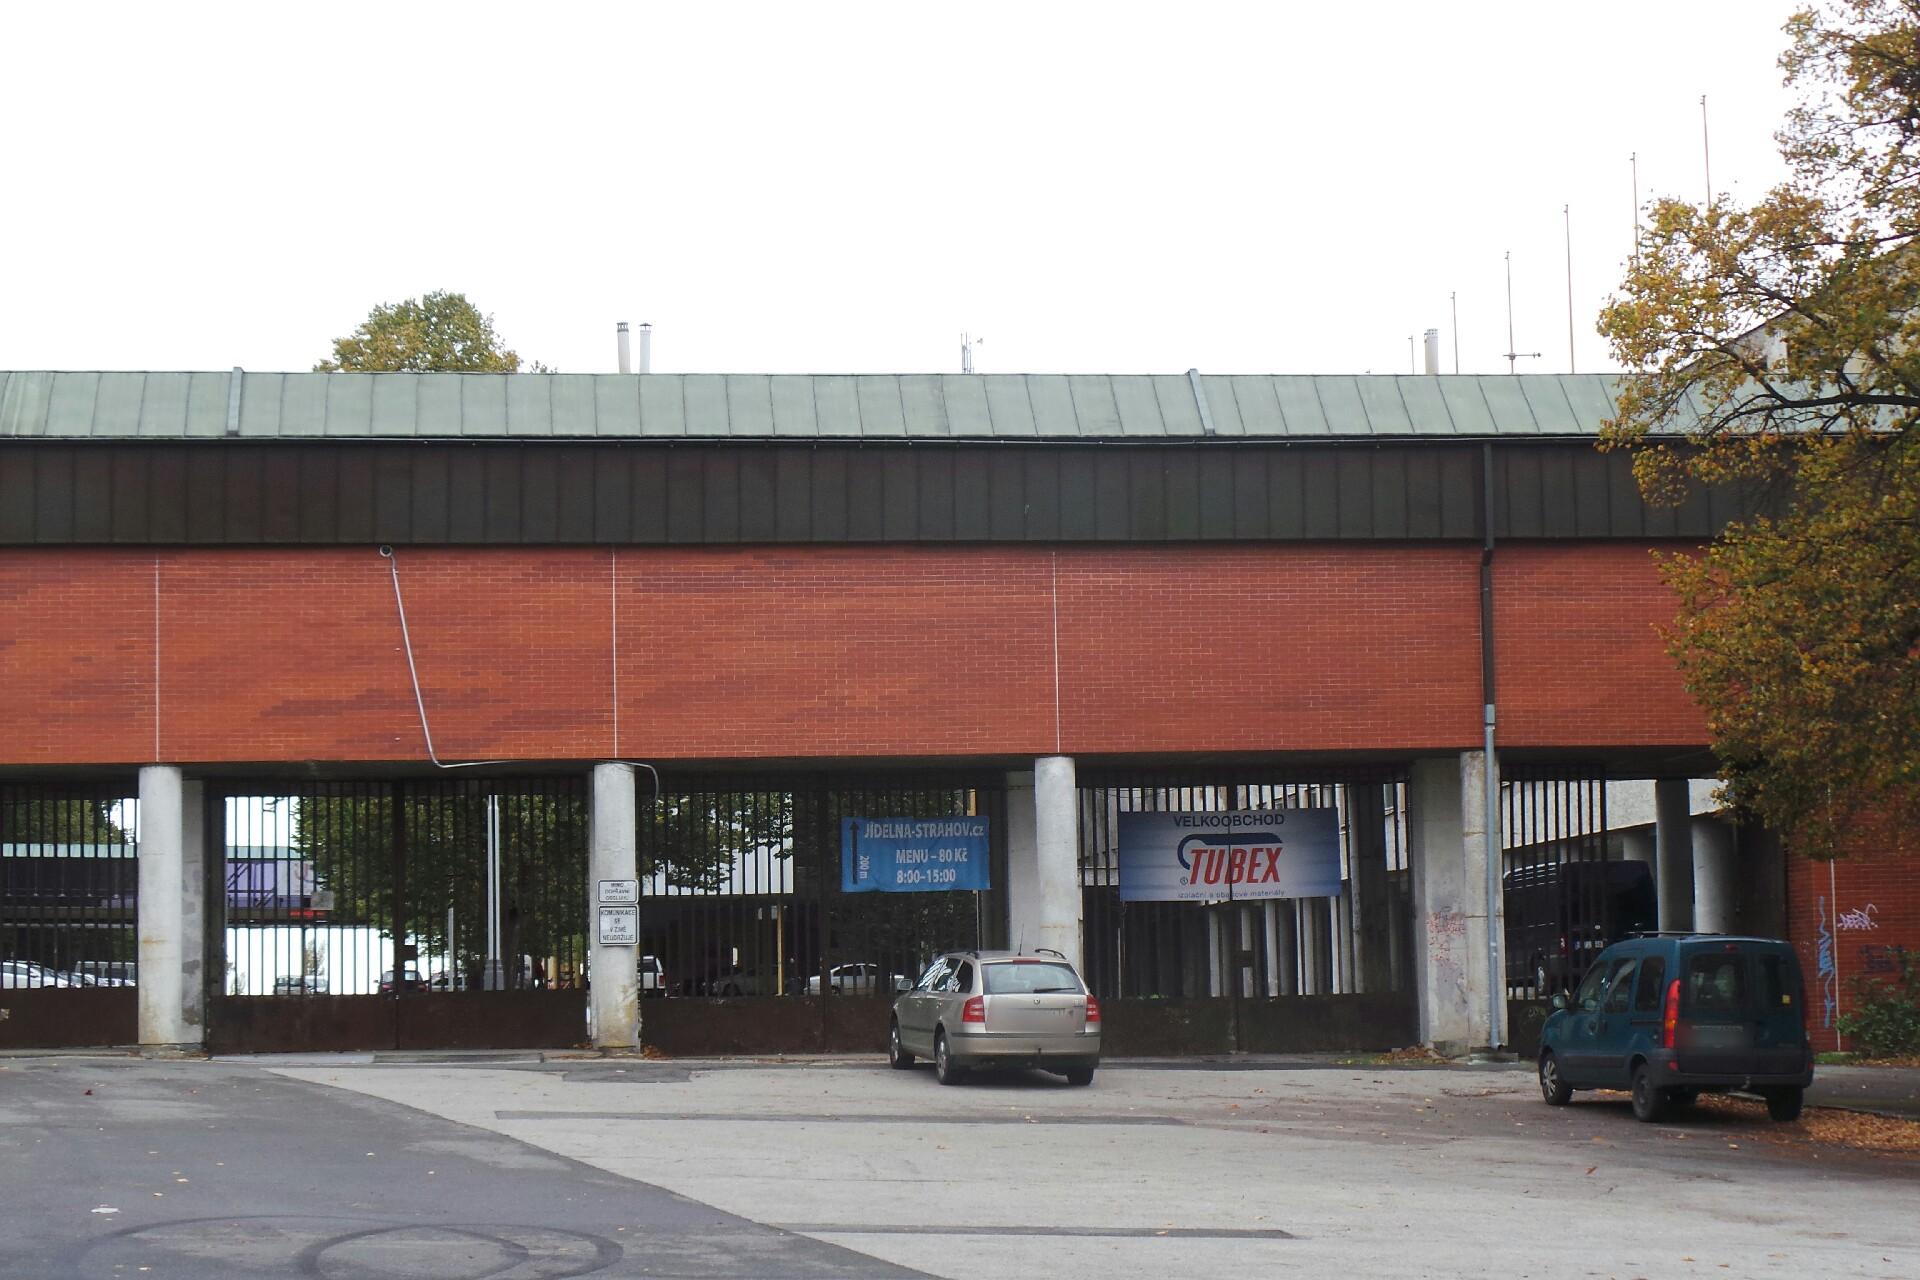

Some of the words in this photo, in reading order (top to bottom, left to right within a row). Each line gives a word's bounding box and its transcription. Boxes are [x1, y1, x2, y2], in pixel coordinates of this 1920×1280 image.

[1174, 814, 1284, 827] VELKOOBCHOD
[864, 822, 984, 839] JÍDELNA-STRAHOV.cz
[859, 855, 870, 870] 200
[896, 849, 928, 863] MENU
[939, 848, 953, 863] 80
[955, 847, 968, 862] Kč
[1190, 848, 1283, 885] TUBEX
